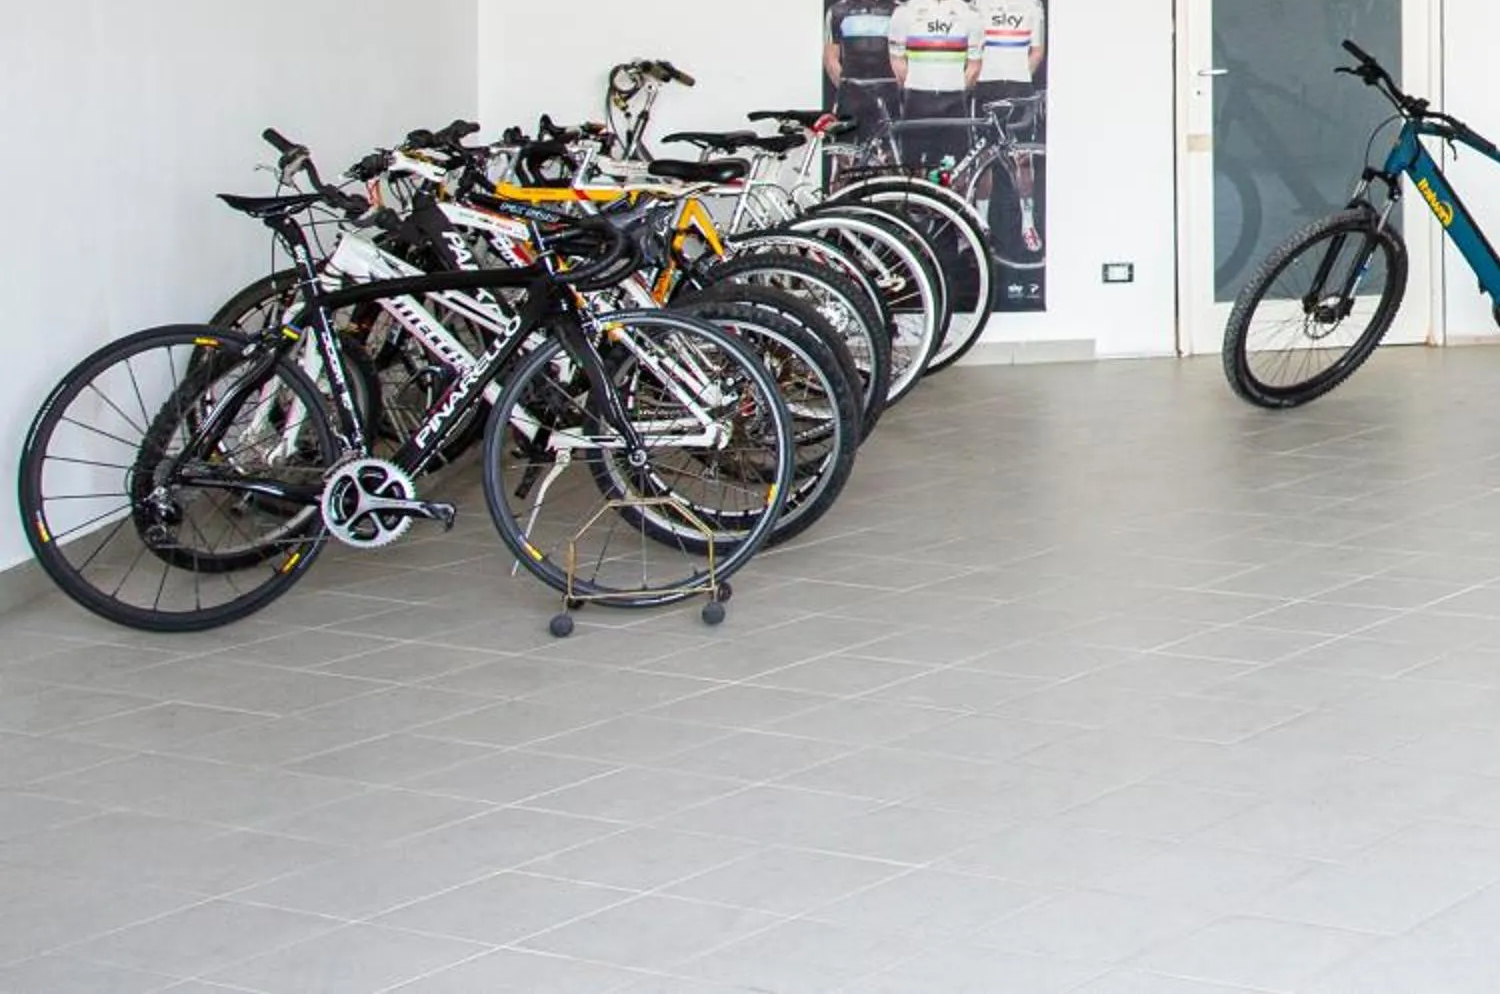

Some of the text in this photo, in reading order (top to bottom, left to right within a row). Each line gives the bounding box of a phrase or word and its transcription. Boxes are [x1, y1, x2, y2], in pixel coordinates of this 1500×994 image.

[927, 19, 952, 33] sky
[991, 14, 1024, 28] sky
[414, 315, 521, 448] PINARELLO
